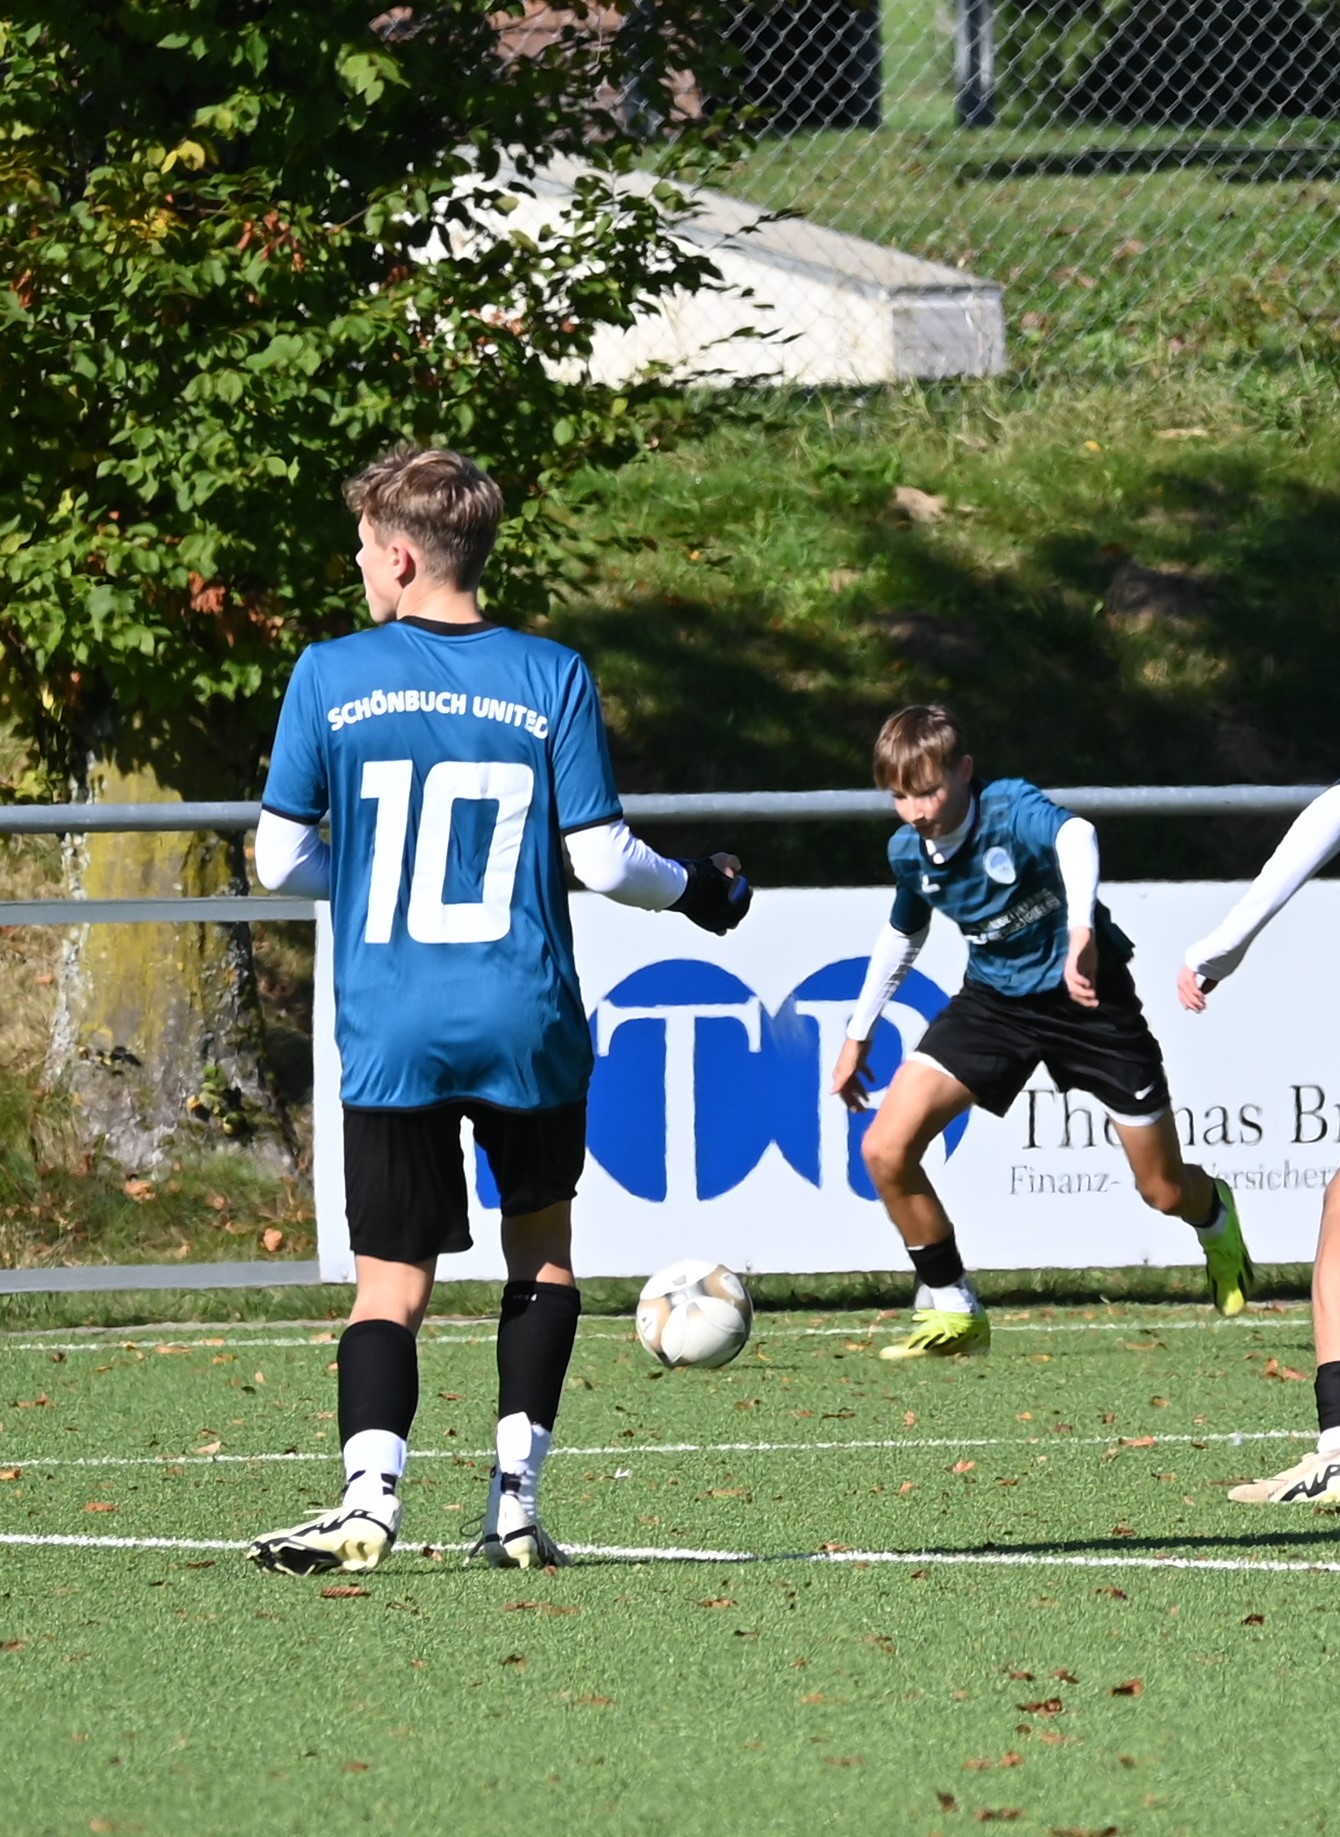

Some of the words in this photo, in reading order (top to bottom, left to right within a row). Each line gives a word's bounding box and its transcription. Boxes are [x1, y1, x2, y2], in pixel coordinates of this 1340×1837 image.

[327, 689, 468, 732] SCHÖNBUCH
[472, 695, 550, 740] UNITED
[359, 758, 535, 945] 10
[1022, 1088, 1264, 1150] Thas
[1009, 1164, 1121, 1195] Finanz-
